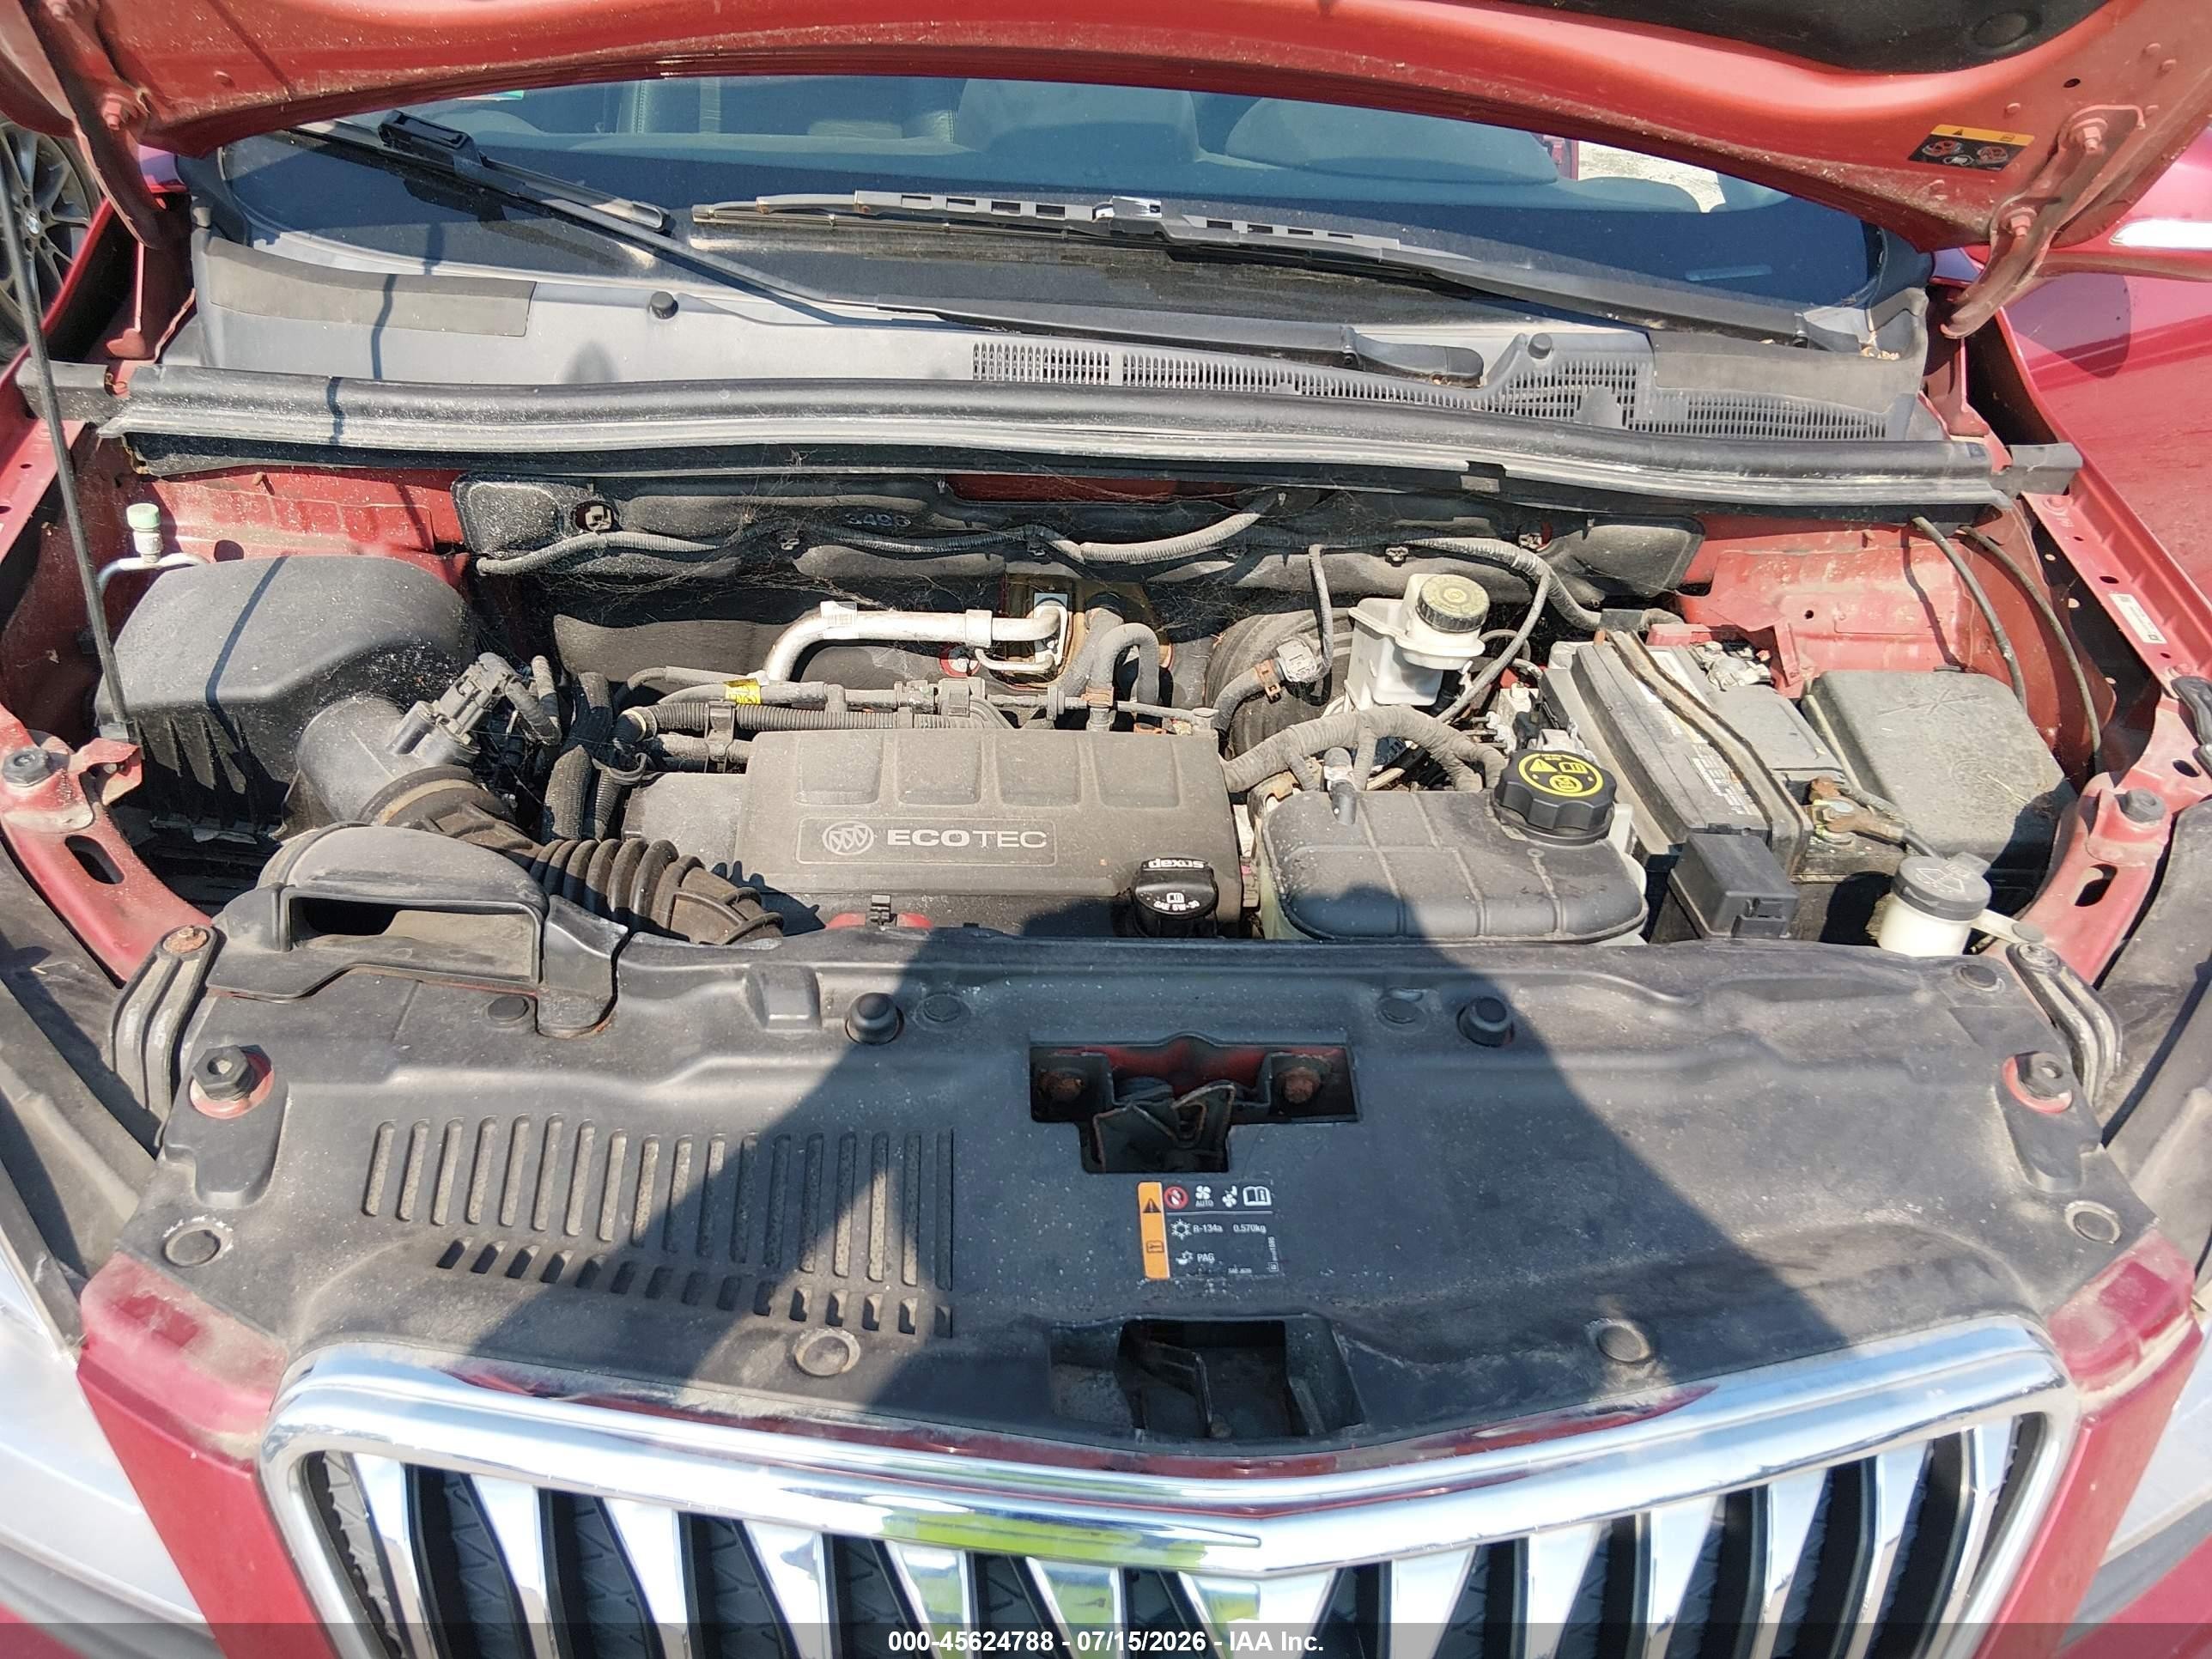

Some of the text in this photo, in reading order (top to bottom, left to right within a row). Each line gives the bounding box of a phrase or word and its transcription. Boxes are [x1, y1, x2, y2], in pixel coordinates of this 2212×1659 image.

[887, 830, 1048, 848] ECOTEC
[1193, 1224, 1224, 1233] R-134a
[1197, 1253, 1215, 1263] PAG
